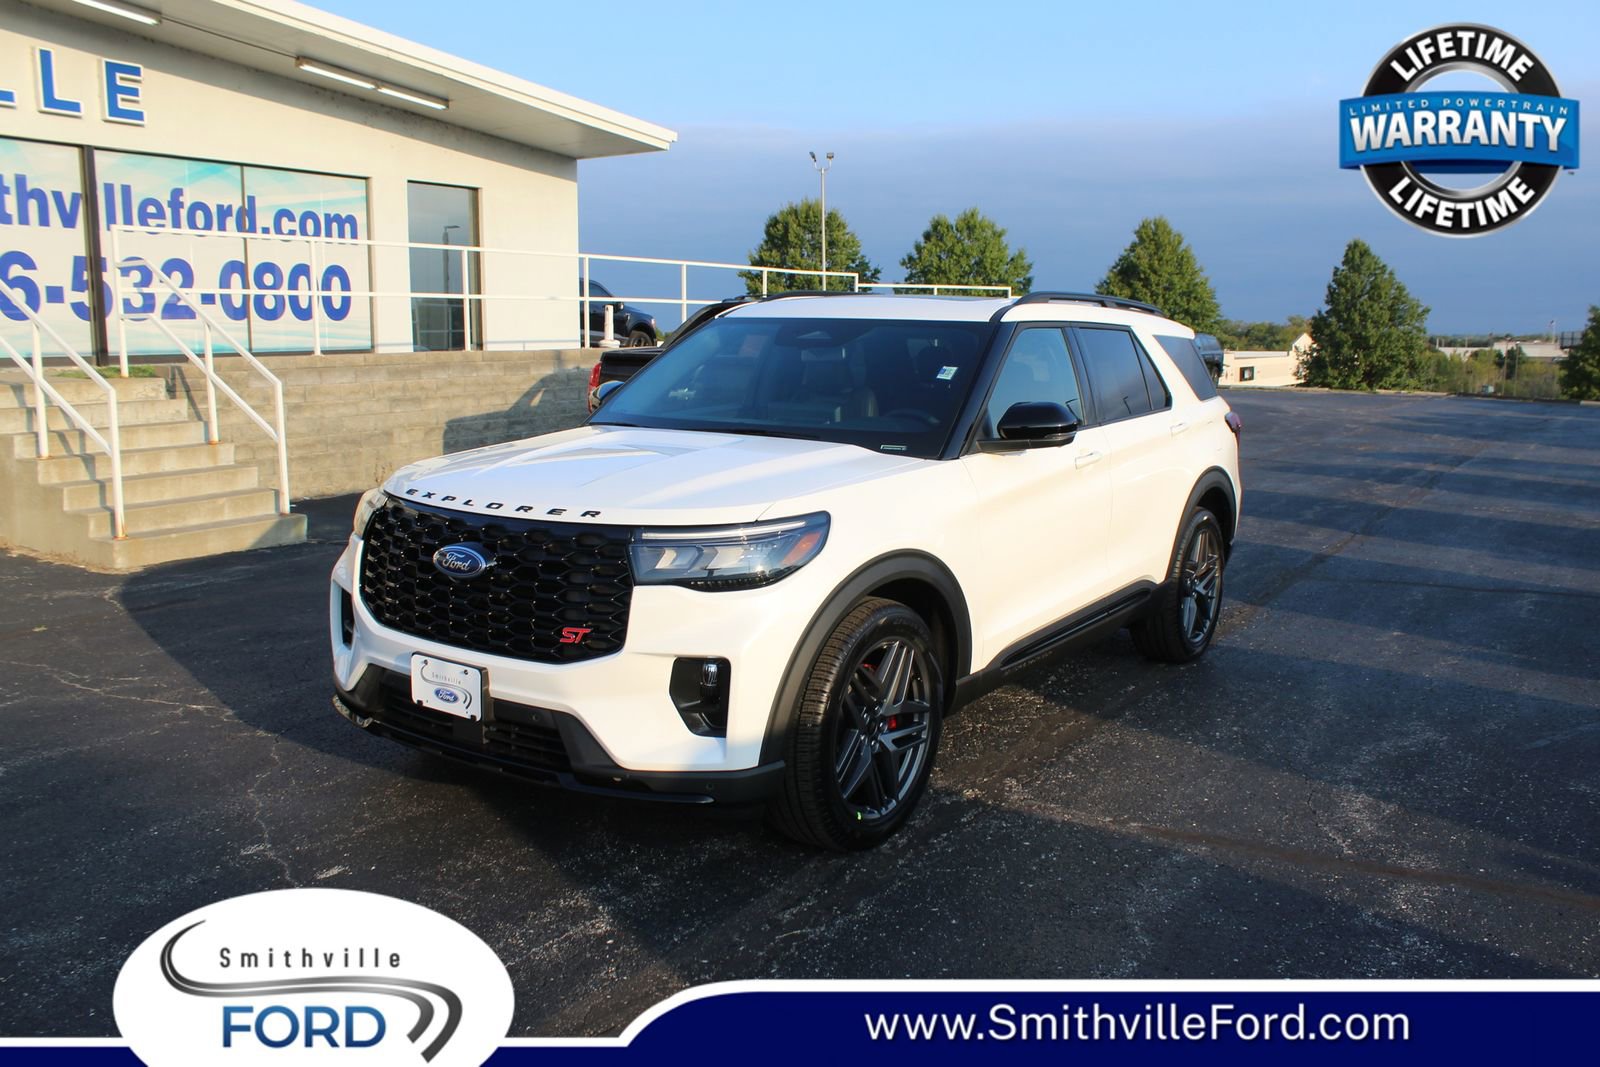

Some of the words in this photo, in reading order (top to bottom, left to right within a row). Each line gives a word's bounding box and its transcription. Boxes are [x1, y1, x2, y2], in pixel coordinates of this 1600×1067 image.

[0, 48, 145, 125] LE
[0, 174, 358, 244] thvlleford.com
[405, 488, 602, 518] EXPLORER
[442, 551, 472, 571] Ford
[559, 627, 593, 644] ST
